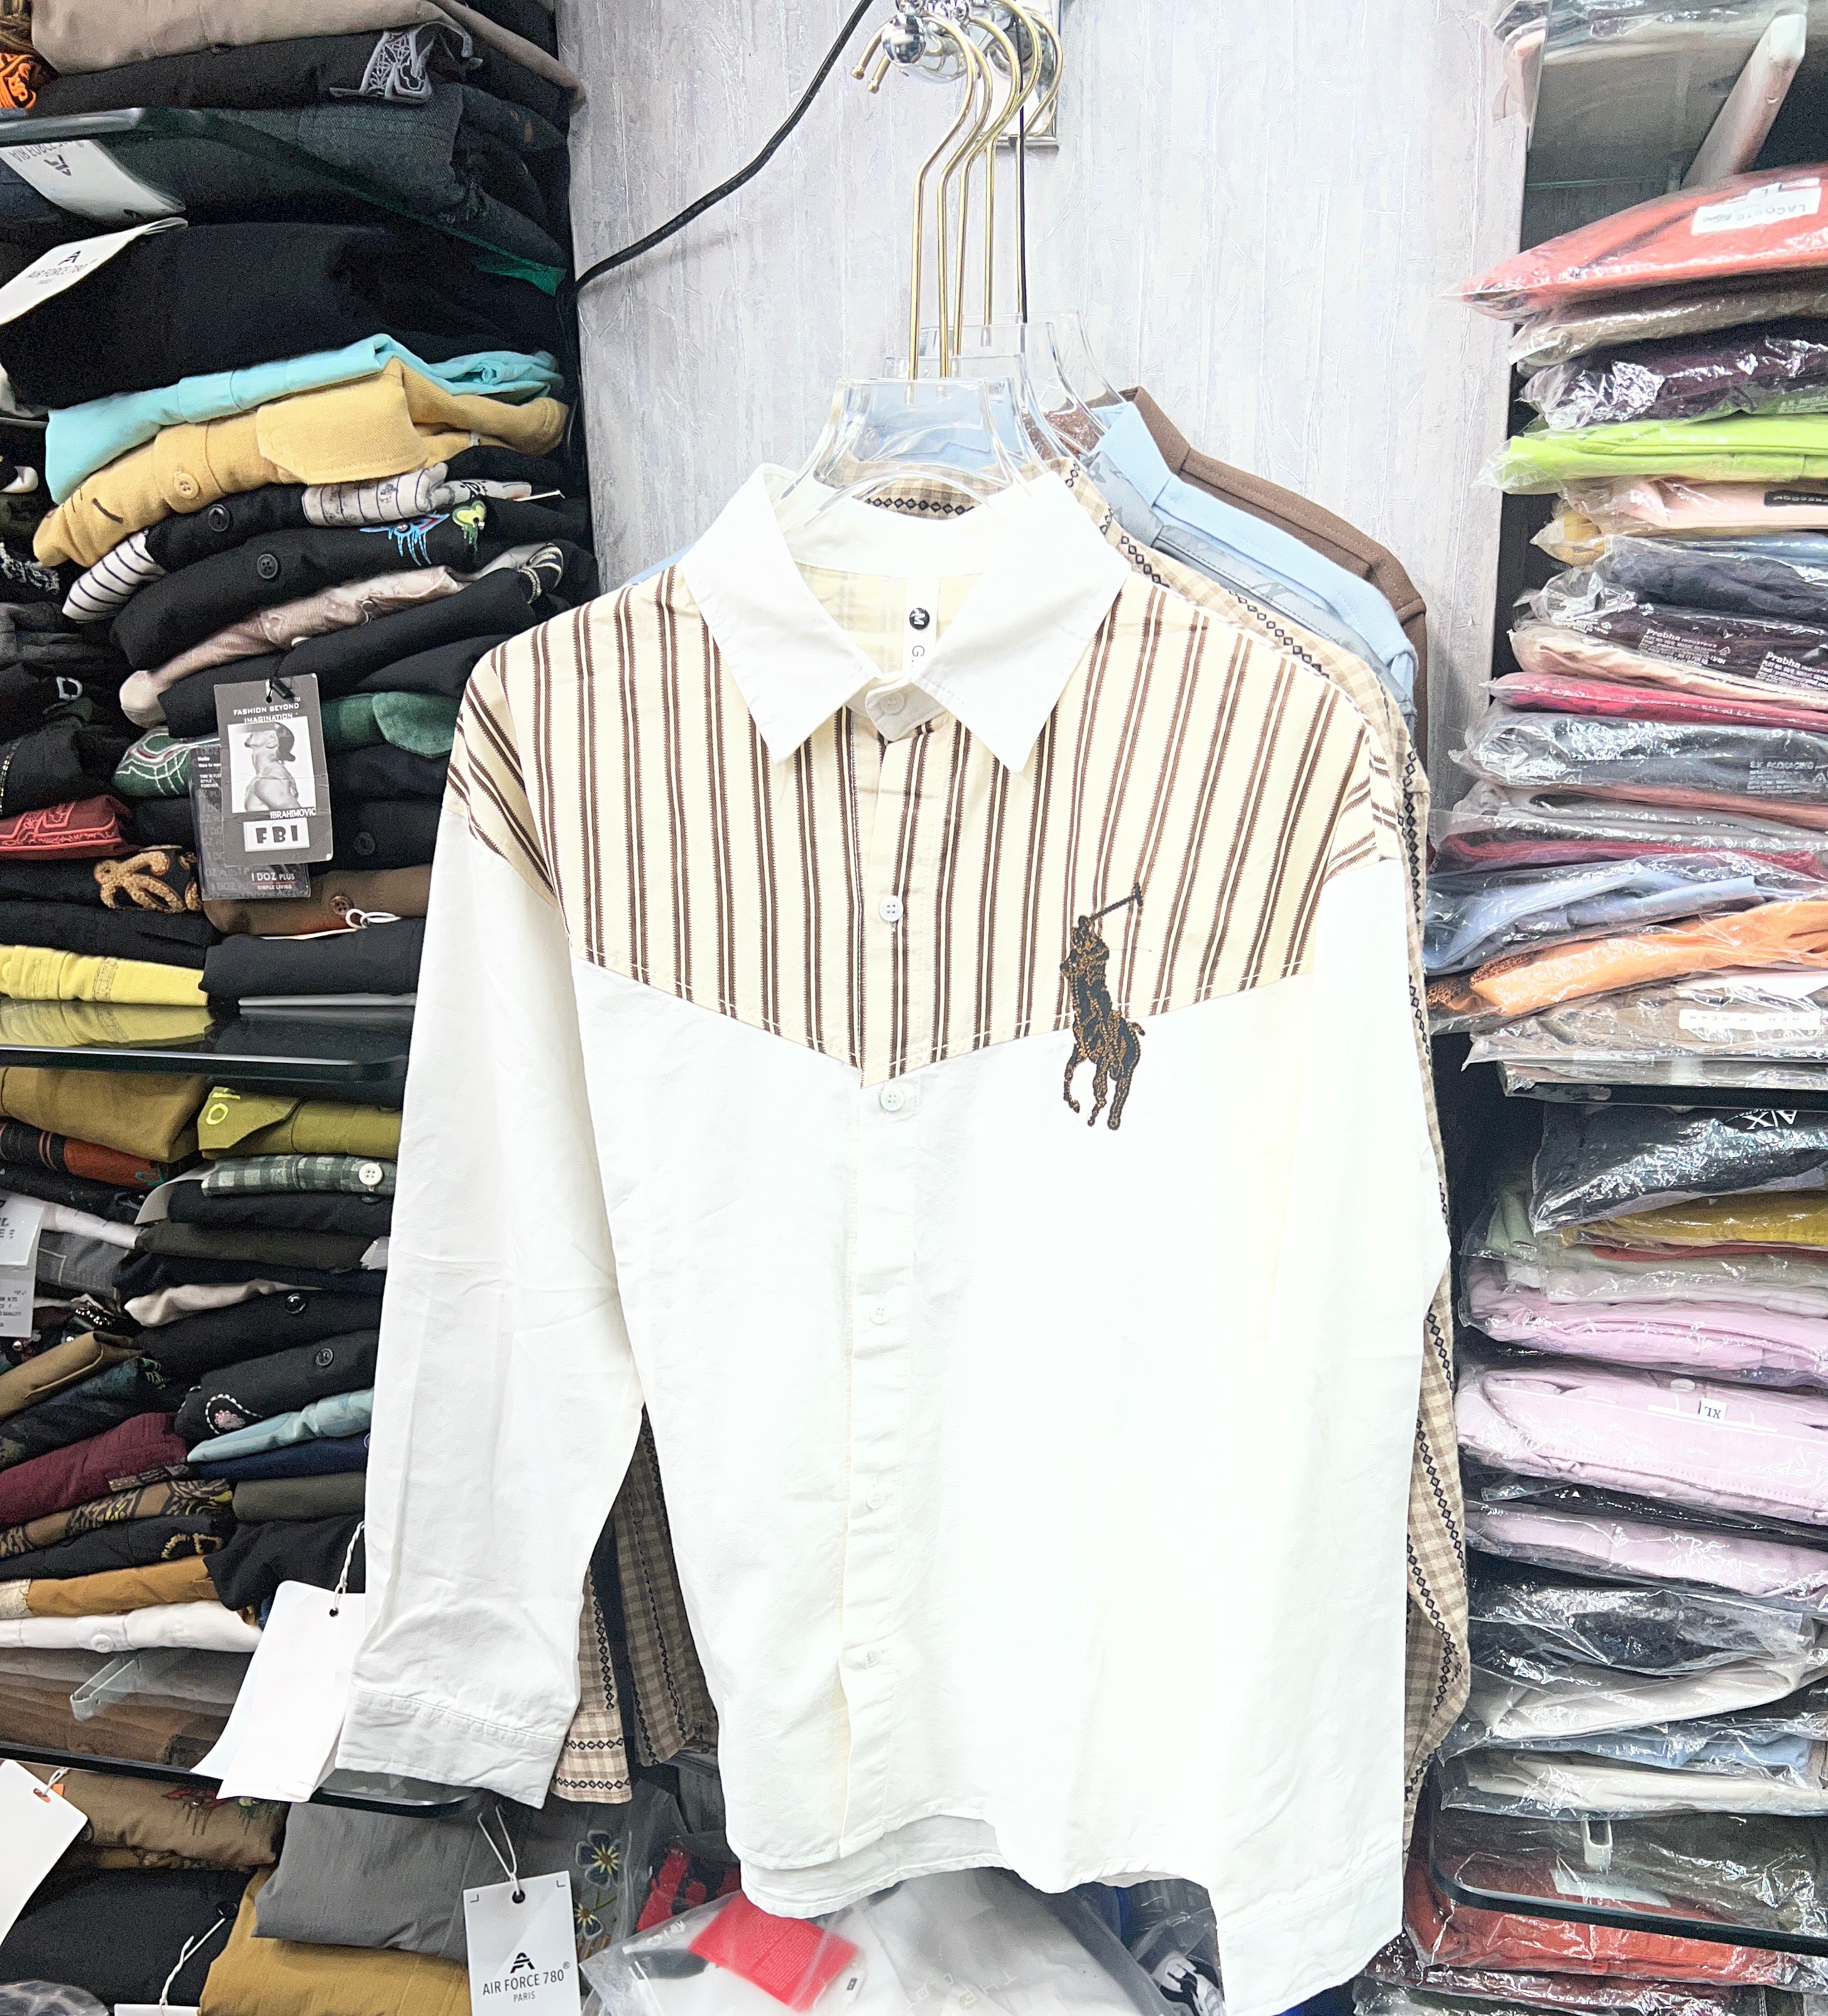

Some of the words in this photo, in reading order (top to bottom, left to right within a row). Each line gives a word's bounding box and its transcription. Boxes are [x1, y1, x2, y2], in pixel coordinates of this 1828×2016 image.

[1646, 628, 1681, 641] Prabha
[1765, 651, 1801, 668] Prabha
[233, 706, 267, 716] FASHION
[269, 702, 300, 712] BEYOND
[244, 712, 293, 723] IMAGINATION
[270, 808, 317, 819] IBRAHIMOVIC
[256, 825, 298, 844] FBI
[256, 872, 277, 881] DOZ
[1704, 1406, 1721, 1419] XL
[483, 1981, 501, 1996] AIR
[505, 1974, 540, 1991] FORCE
[513, 1991, 535, 2002] PARIS
